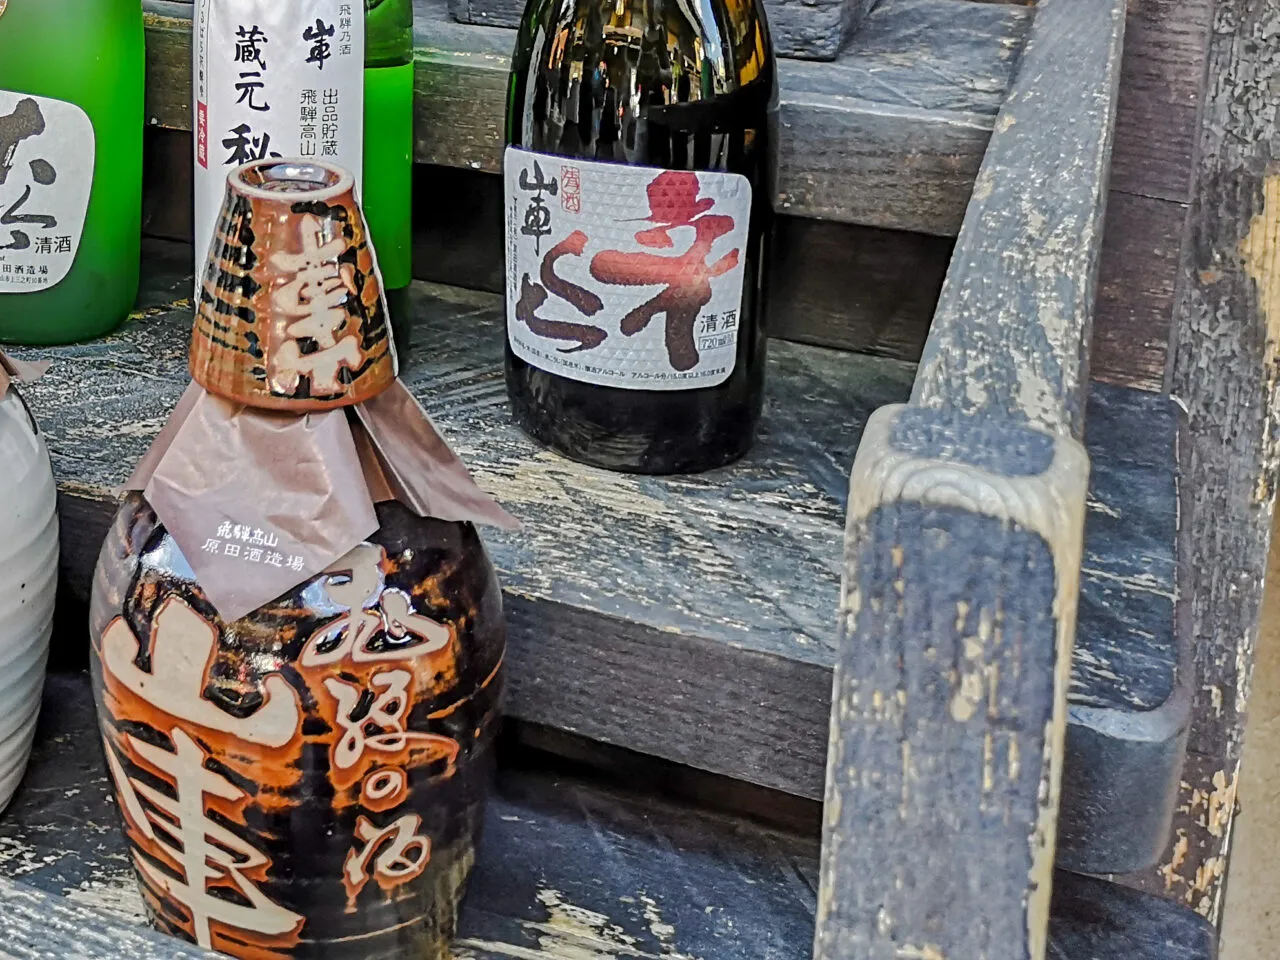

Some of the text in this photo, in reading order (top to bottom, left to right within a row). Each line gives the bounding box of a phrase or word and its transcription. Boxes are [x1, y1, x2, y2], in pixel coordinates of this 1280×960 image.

[300, 89, 317, 157] 飛騨高山
[321, 88, 338, 157] 出品貯蔵
[35, 235, 72, 254] 清酒
[700, 309, 737, 333] 清酒
[216, 521, 278, 547] 飛騨高山
[201, 538, 305, 571] 原田酒造場
